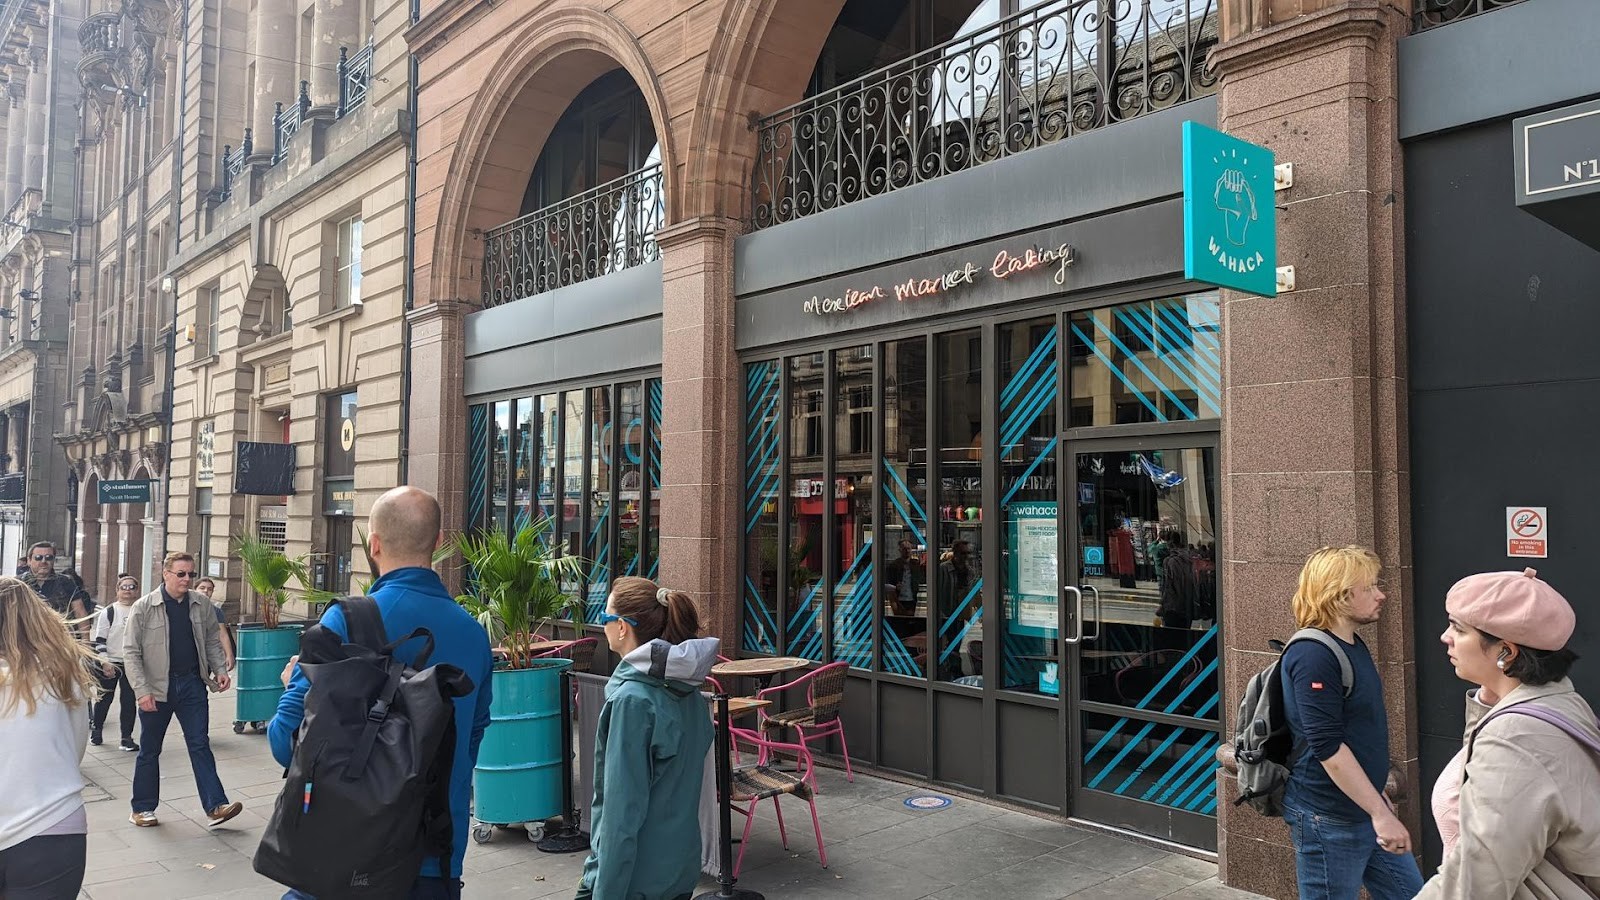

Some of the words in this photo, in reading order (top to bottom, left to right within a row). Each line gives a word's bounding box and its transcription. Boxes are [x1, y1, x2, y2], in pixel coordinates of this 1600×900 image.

[1208, 235, 1264, 273] WAHACA
[803, 286, 885, 315] Mexican
[894, 261, 982, 301] Market
[990, 243, 1074, 285] Eating
[1017, 505, 1058, 516] wahaca
[1084, 566, 1103, 576] PULL
